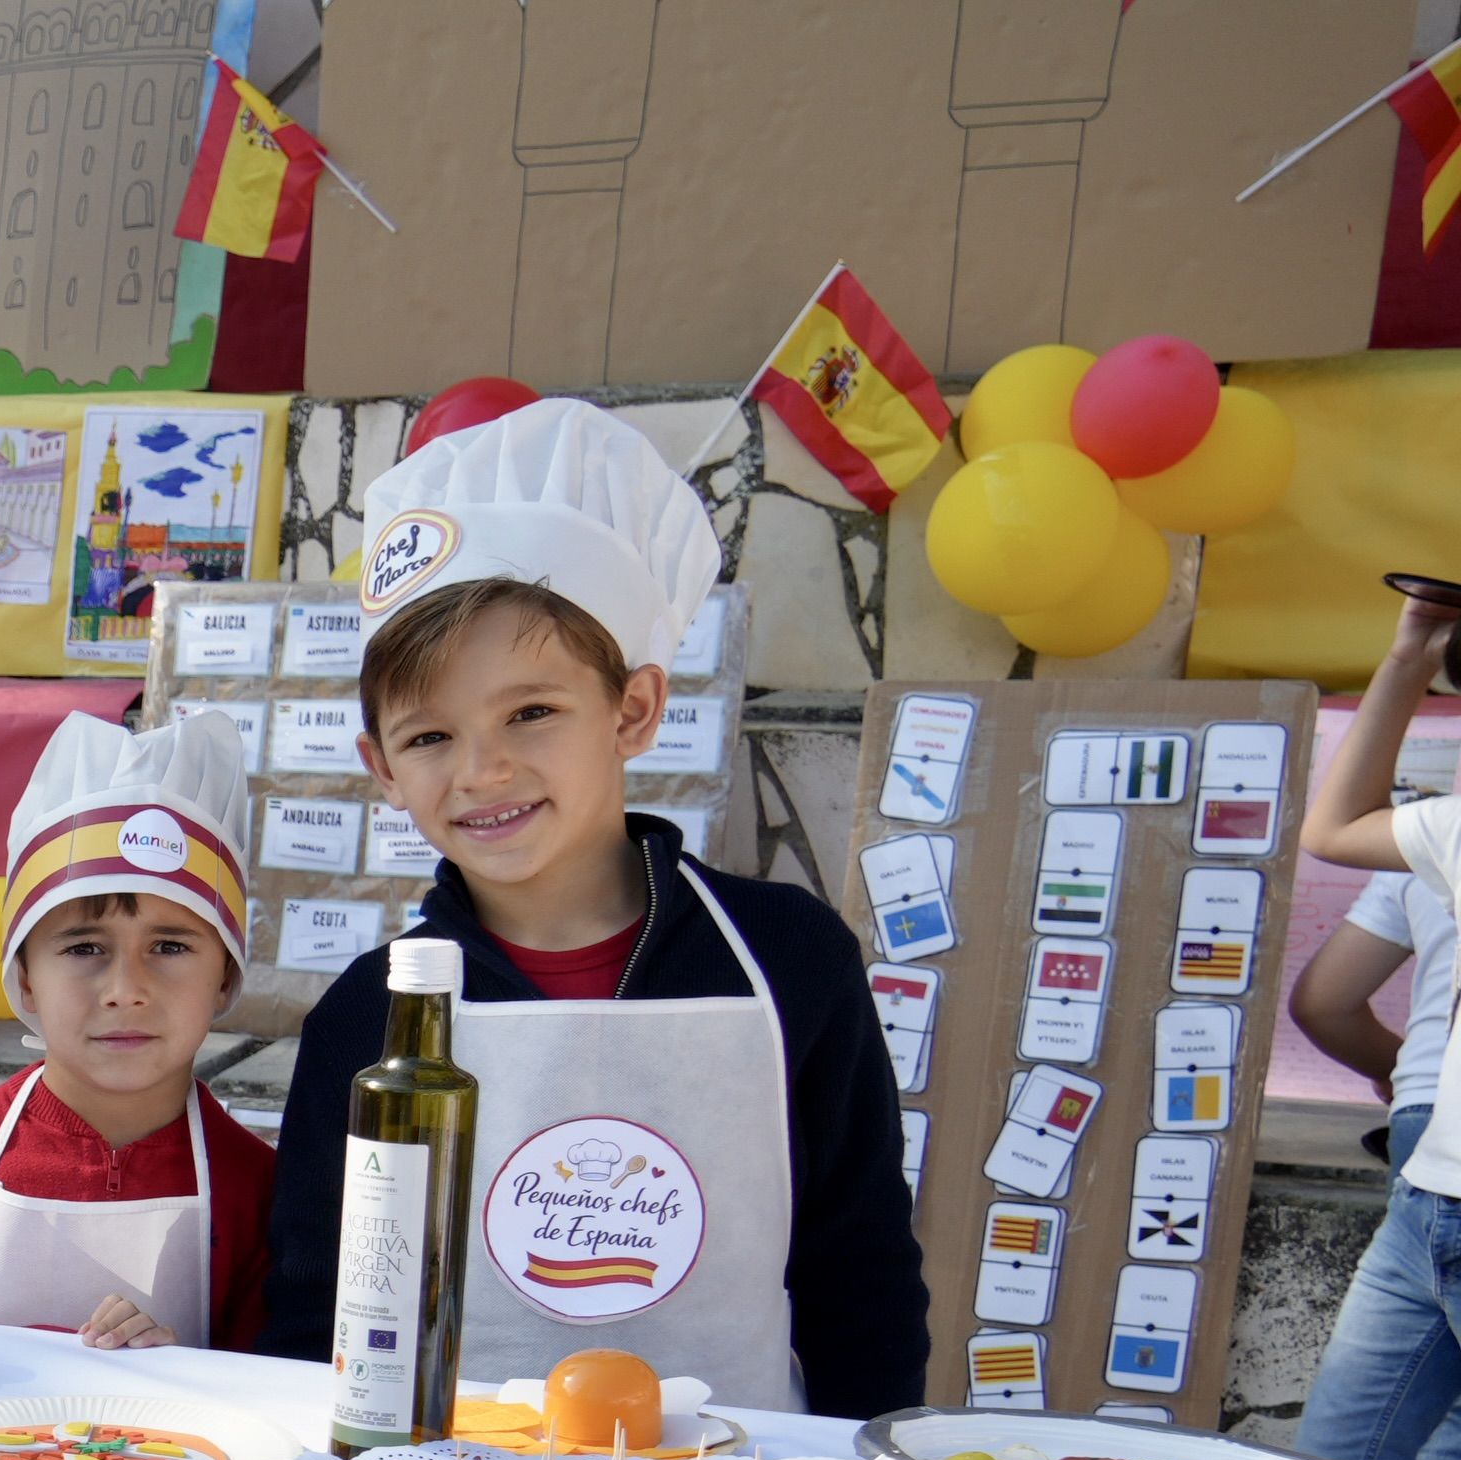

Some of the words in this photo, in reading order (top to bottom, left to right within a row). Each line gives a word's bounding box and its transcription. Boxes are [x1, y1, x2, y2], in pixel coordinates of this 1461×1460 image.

[375, 525, 420, 572] Chef
[373, 556, 432, 597] Marco
[203, 615, 246, 630] GALICIA
[306, 615, 360, 632] ASTURIAS
[298, 712, 311, 727] LA
[315, 712, 346, 727] RIOJA
[661, 709, 697, 724] ENCIA
[373, 821, 409, 833] CASTILLA
[123, 832, 182, 855] Manuel
[312, 910, 347, 928] CEUTA
[513, 1172, 616, 1215] Pequeños
[620, 1187, 684, 1225] chefs
[357, 1234, 414, 1257] OLIVA
[533, 1214, 563, 1240] de
[566, 1215, 658, 1255] España
[343, 1248, 405, 1276] VIRGEN
[344, 1269, 396, 1295] EXTRA
